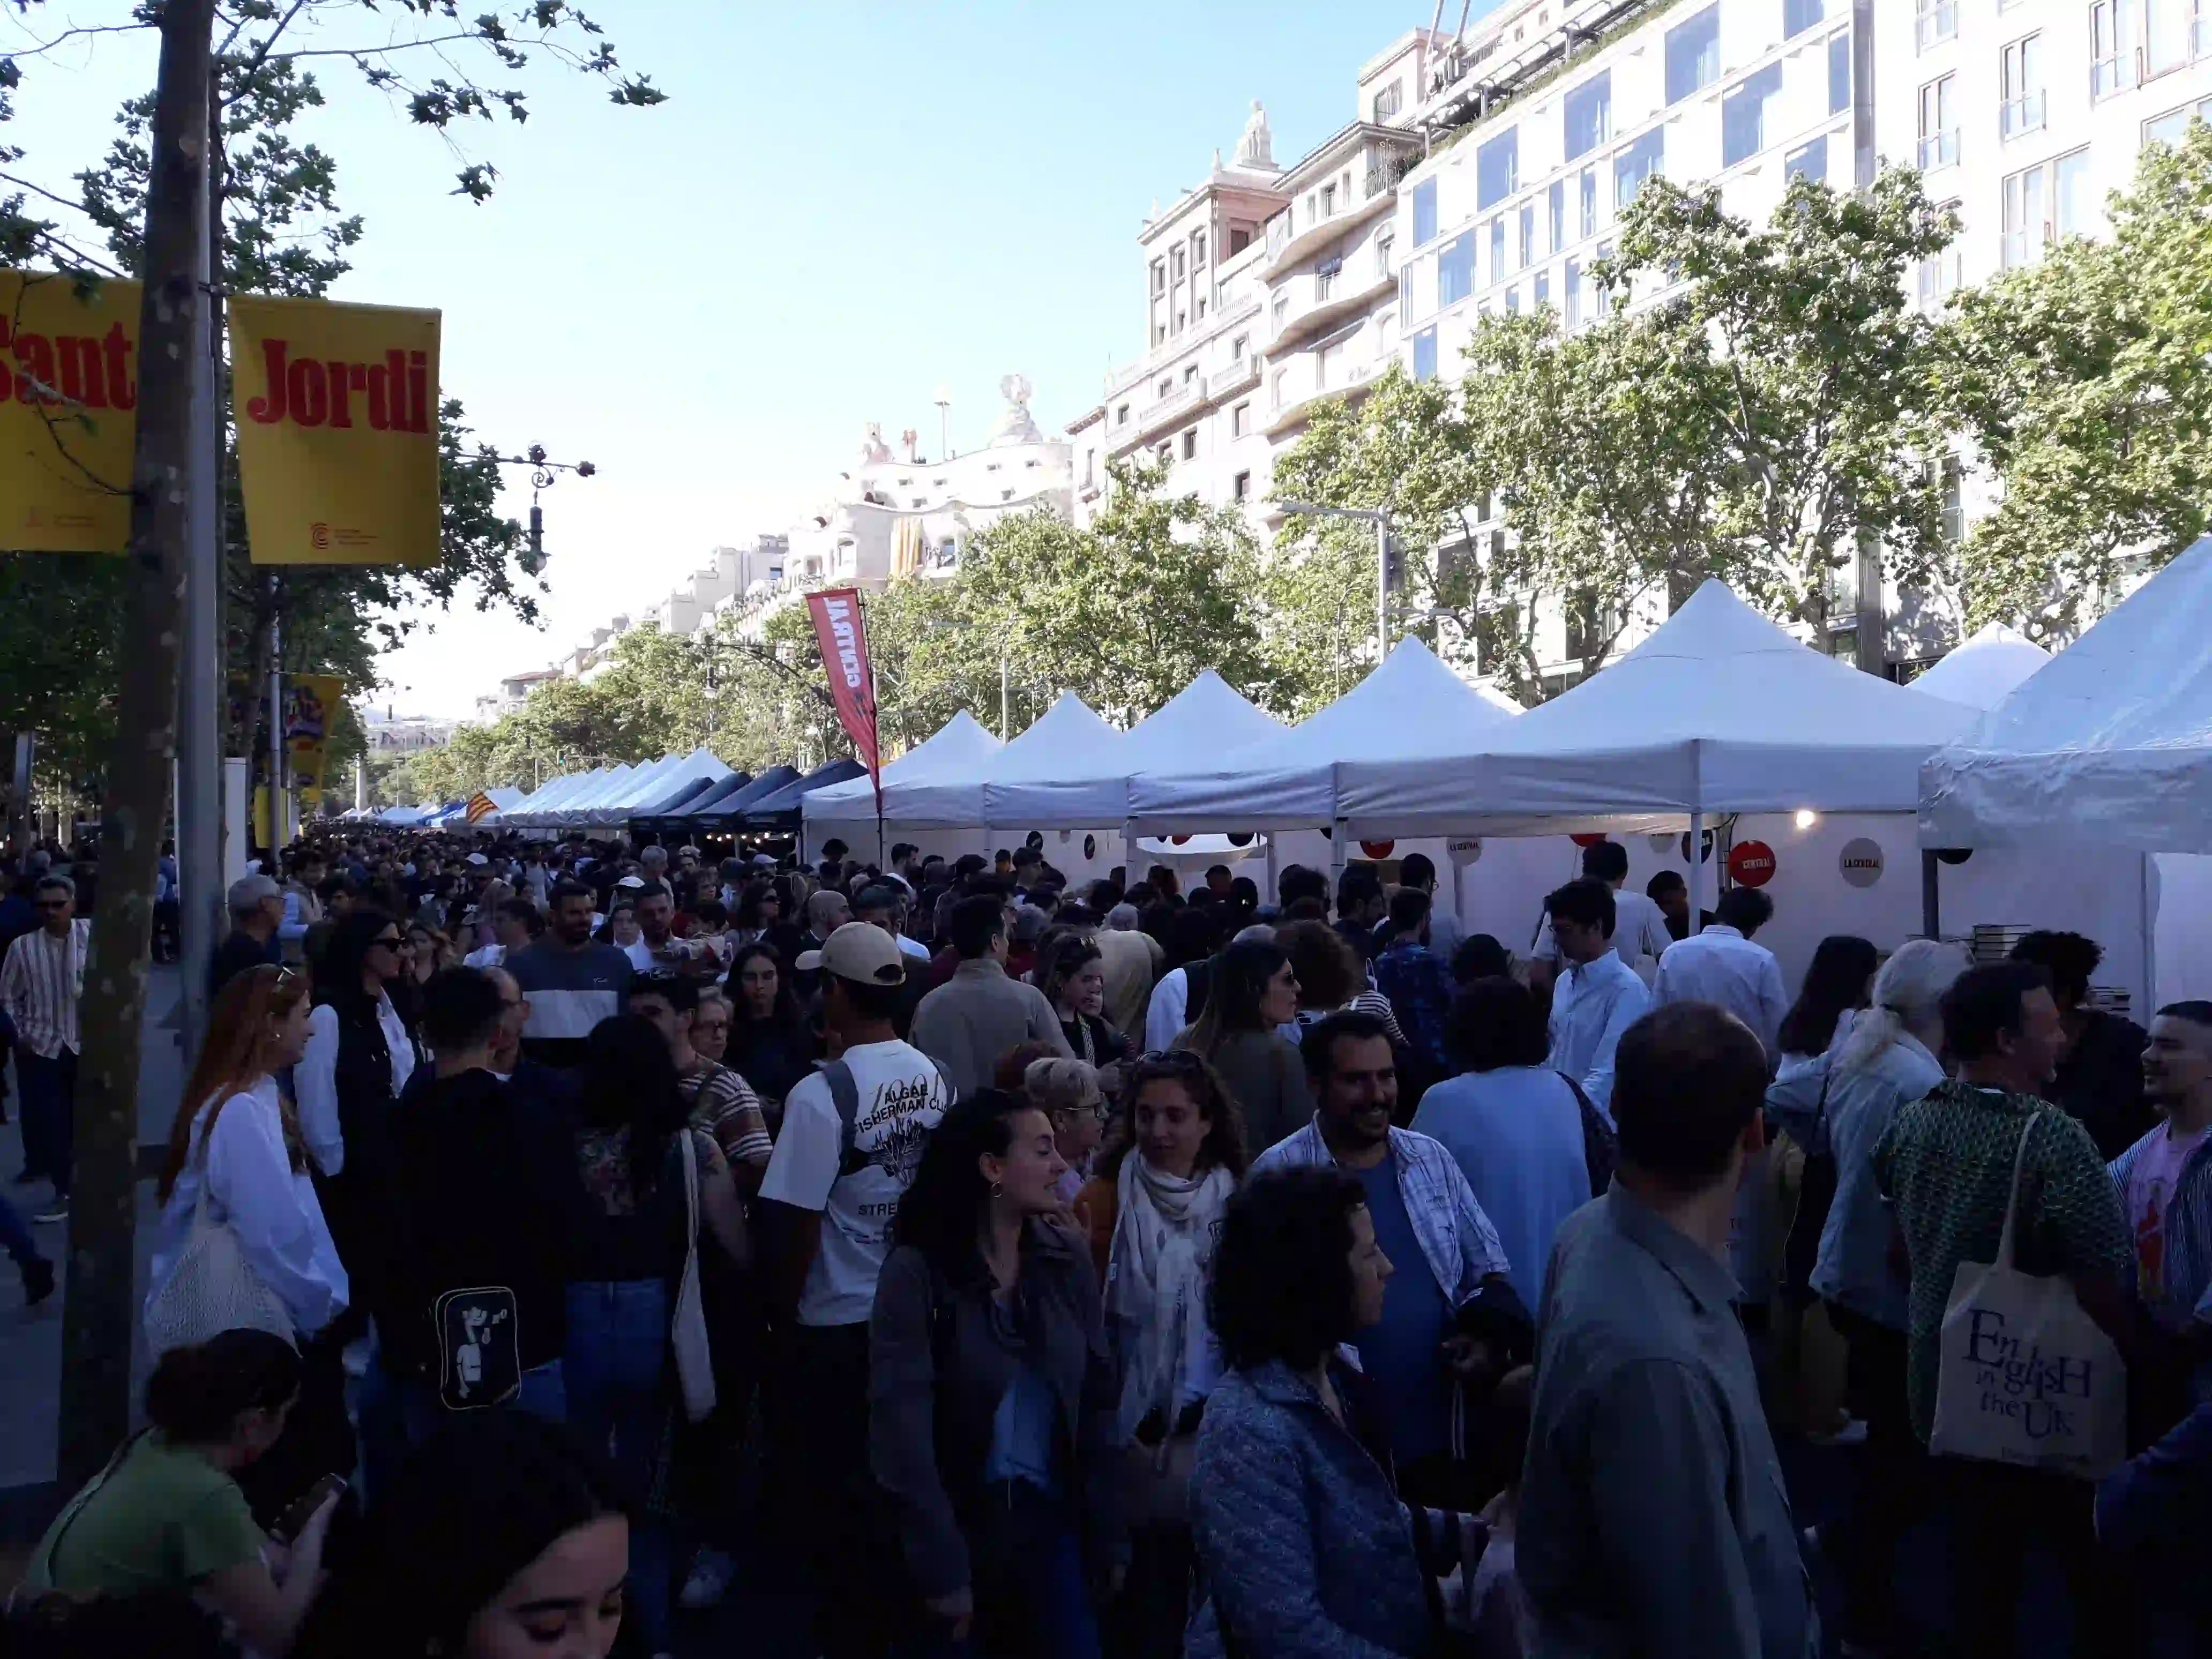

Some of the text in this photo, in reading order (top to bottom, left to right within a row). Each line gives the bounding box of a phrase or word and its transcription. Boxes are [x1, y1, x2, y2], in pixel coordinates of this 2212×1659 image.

[247, 338, 428, 435] Jordi
[885, 1085, 929, 1104] ALGAE
[856, 1098, 925, 1134] ISHERMAN
[858, 1203, 900, 1216] STRE
